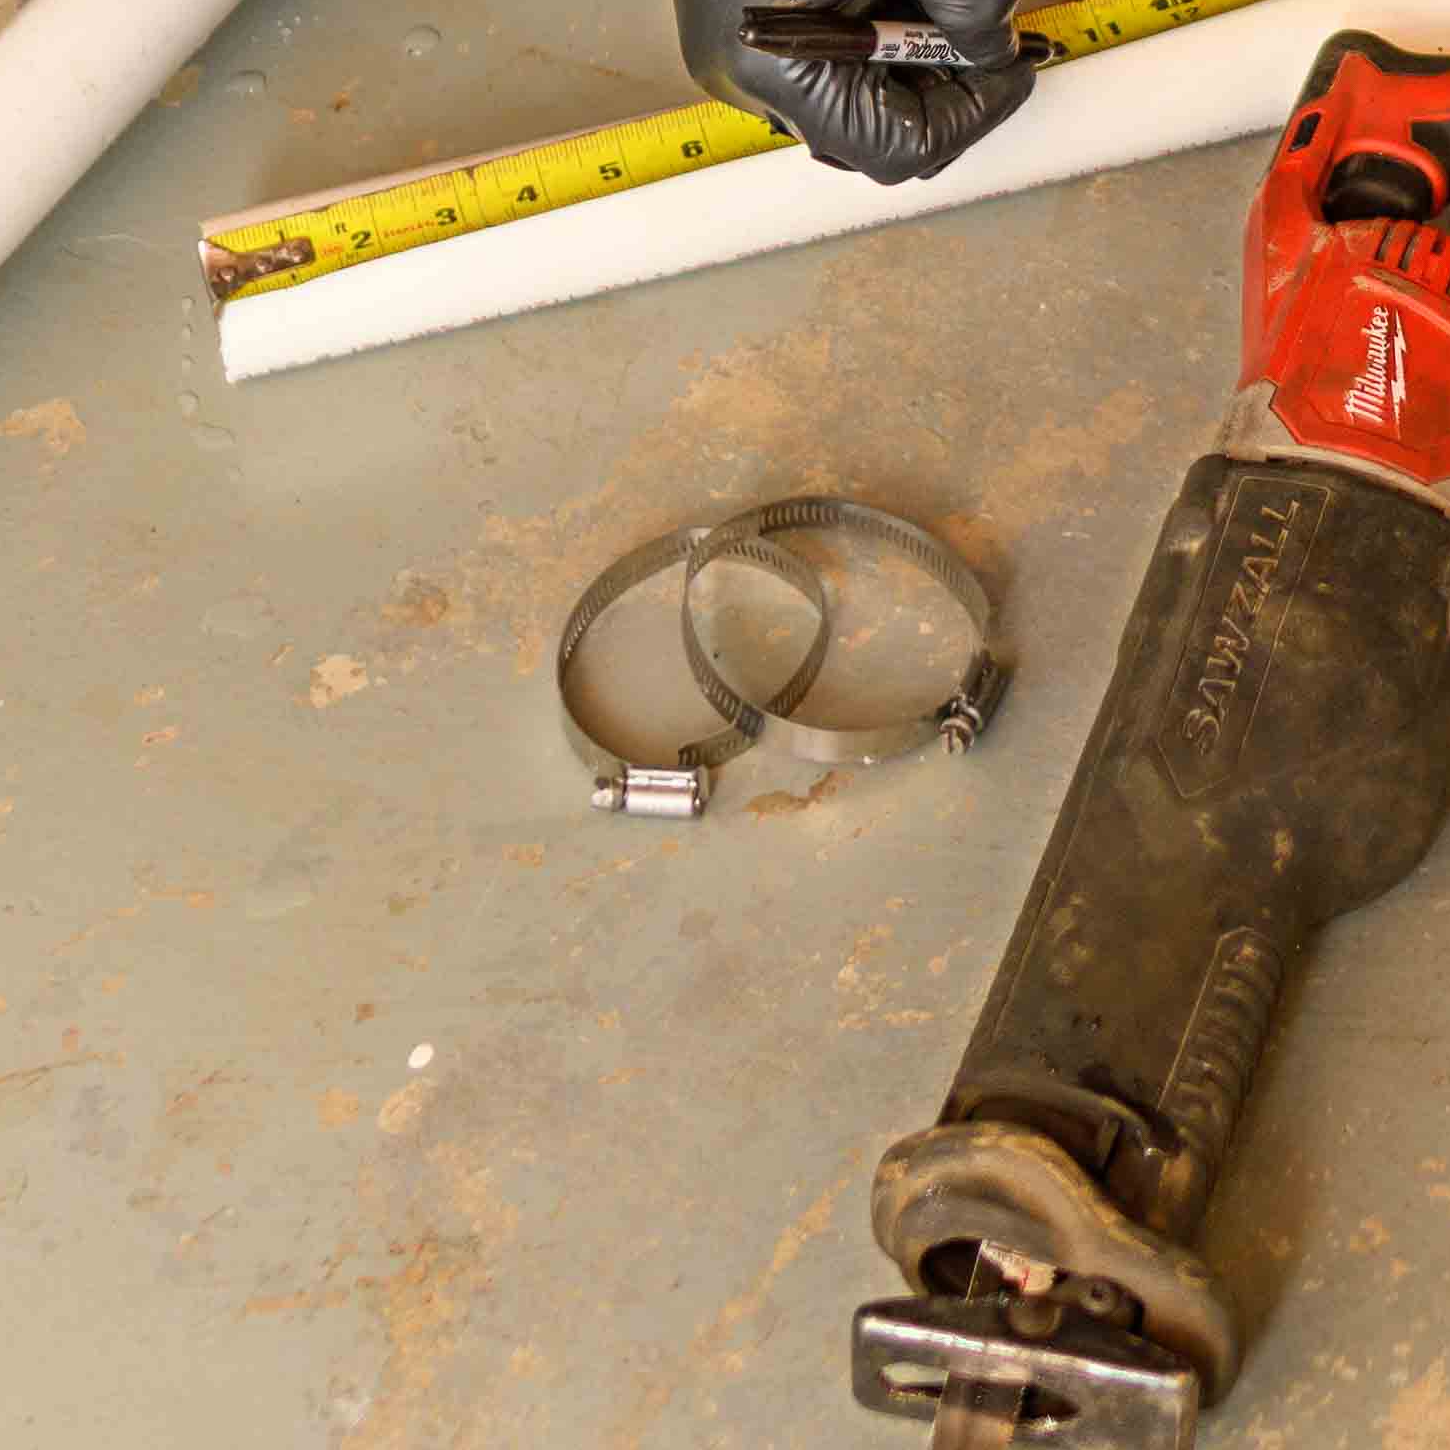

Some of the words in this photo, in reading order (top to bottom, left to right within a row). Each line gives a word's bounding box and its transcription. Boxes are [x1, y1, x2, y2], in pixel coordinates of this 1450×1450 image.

[1083, 20, 1122, 43] 11
[351, 230, 371, 250] 2
[435, 206, 458, 227] 3
[516, 184, 539, 203] 4
[599, 161, 623, 182] 5
[681, 140, 704, 159] 6
[1345, 305, 1389, 426] Milwaukee
[1182, 500, 1301, 758] SAWZALL
